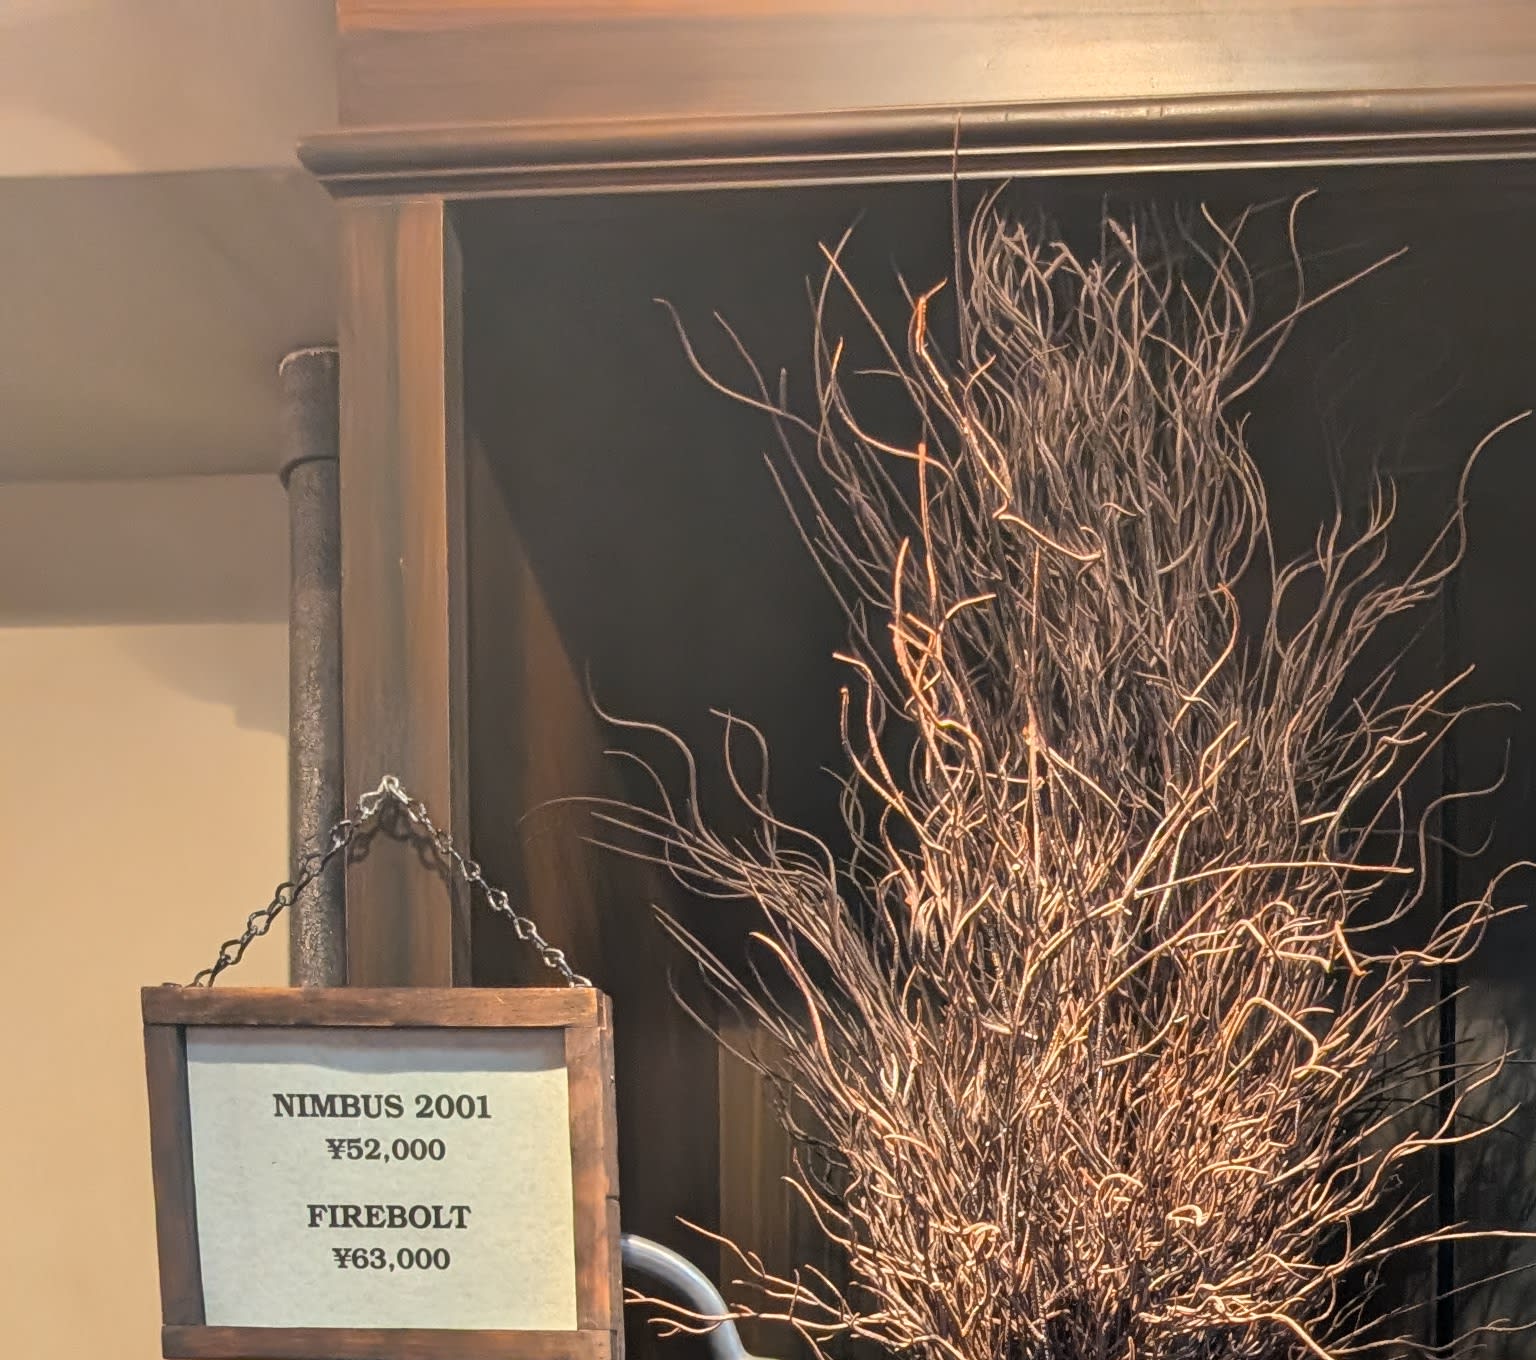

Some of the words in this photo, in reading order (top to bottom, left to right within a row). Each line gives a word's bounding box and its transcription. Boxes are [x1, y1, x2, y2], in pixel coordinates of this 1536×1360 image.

[272, 1093, 404, 1119] NIMBUS
[414, 1094, 491, 1119] 2001
[325, 1137, 446, 1164] ¥52,000
[307, 1204, 472, 1230] FIREBOLT
[331, 1247, 451, 1273] ¥63,000
